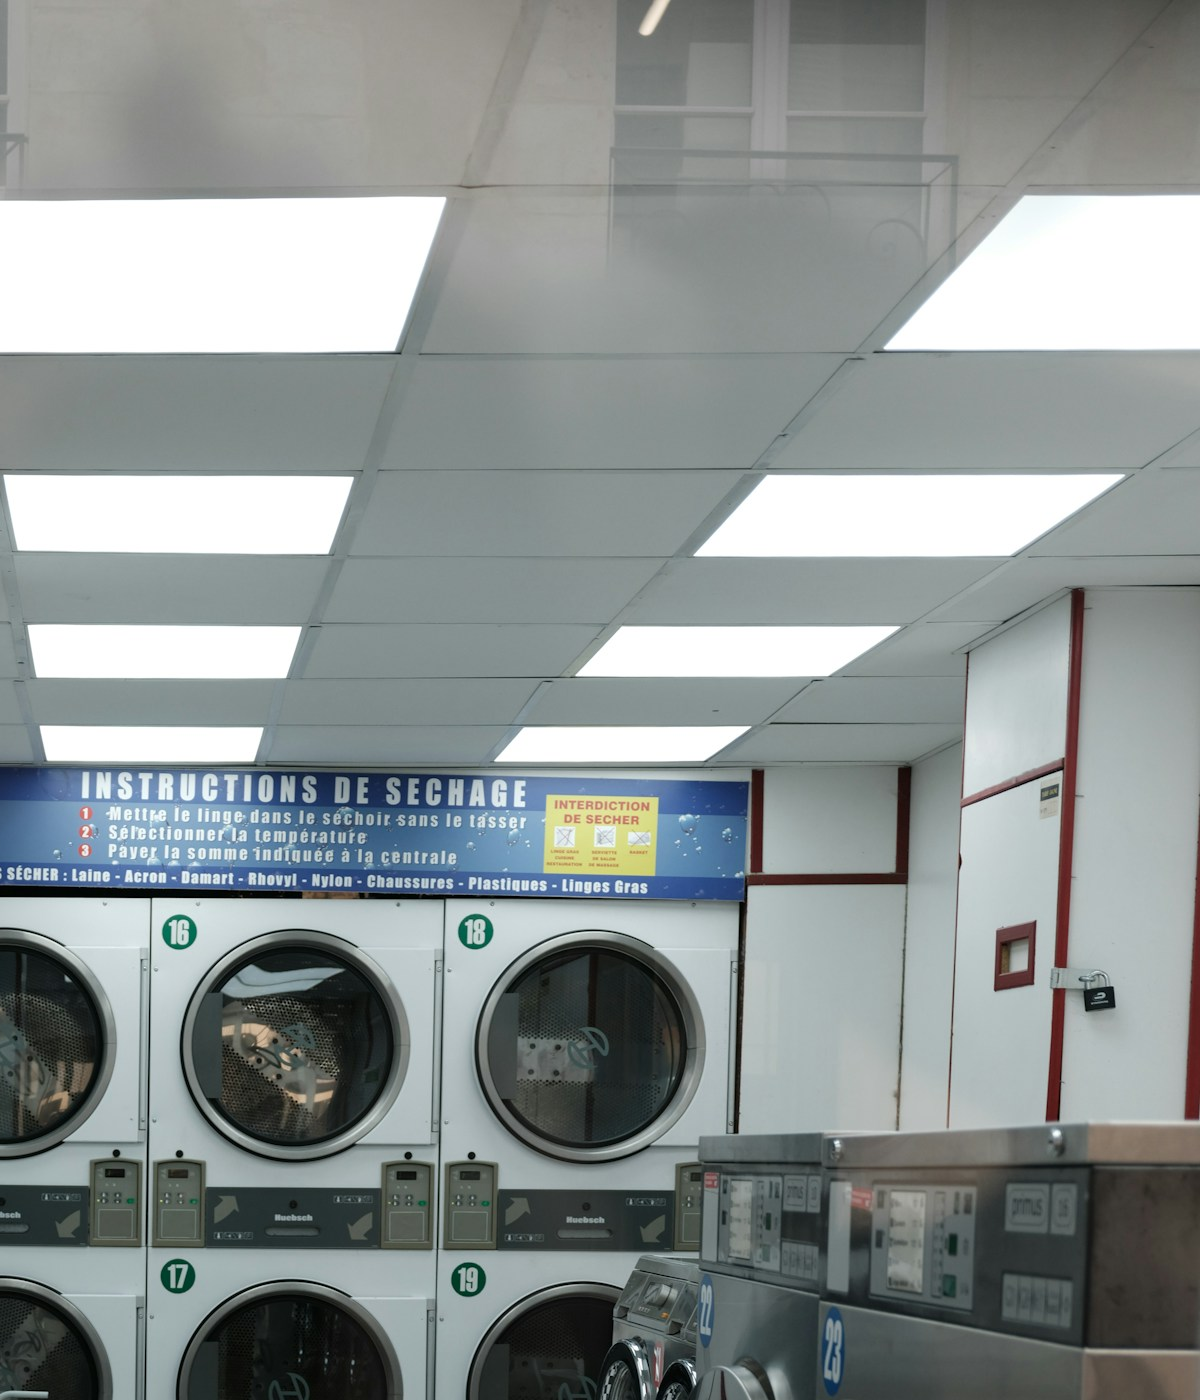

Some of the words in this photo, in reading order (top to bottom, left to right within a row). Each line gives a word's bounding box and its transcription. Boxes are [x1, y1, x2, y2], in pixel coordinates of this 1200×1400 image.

[81, 771, 318, 804] INSTRUCTIONS
[333, 774, 369, 805] DE
[385, 776, 527, 808] SECHAGE
[82, 808, 90, 820] 1
[108, 806, 168, 823] Mettre
[173, 807, 190, 823] le
[198, 807, 245, 827] linge
[249, 808, 292, 825] dans
[299, 809, 315, 825] le
[322, 810, 391, 827] séchoir
[397, 814, 439, 828] sans
[445, 812, 462, 828] le
[469, 813, 527, 829] tasser
[553, 799, 651, 812] INTERDICTION
[563, 813, 582, 824] DE
[585, 813, 640, 826] SECHER
[81, 826, 90, 838] 2
[108, 824, 225, 842] Sélectionner
[231, 827, 248, 842] la
[254, 828, 367, 846] température
[81, 844, 90, 857] 3
[108, 844, 158, 862] Payer
[164, 844, 180, 859] la
[187, 848, 248, 861] somme
[255, 846, 334, 865] indiquée
[341, 848, 351, 863] à
[357, 849, 374, 864] la
[381, 849, 457, 866] centrale
[6, 864, 59, 882] SÉCHER
[71, 868, 111, 883] Laine
[124, 870, 168, 884] Acron
[181, 871, 234, 885] Damart
[248, 872, 297, 889] Rhovyl
[311, 873, 352, 889] Nylon
[366, 875, 454, 890] Chaussures
[468, 877, 548, 894] Plastiques
[561, 879, 611, 895] Linges
[614, 879, 648, 894] Gras
[168, 919, 190, 946] 16
[464, 918, 486, 945] 18
[274, 1213, 314, 1222] Huebsch
[566, 1215, 605, 1224] Huebsch
[166, 1263, 188, 1289] 17
[457, 1266, 478, 1293] 19
[700, 1282, 713, 1337] 22
[822, 1317, 842, 1385] 23
